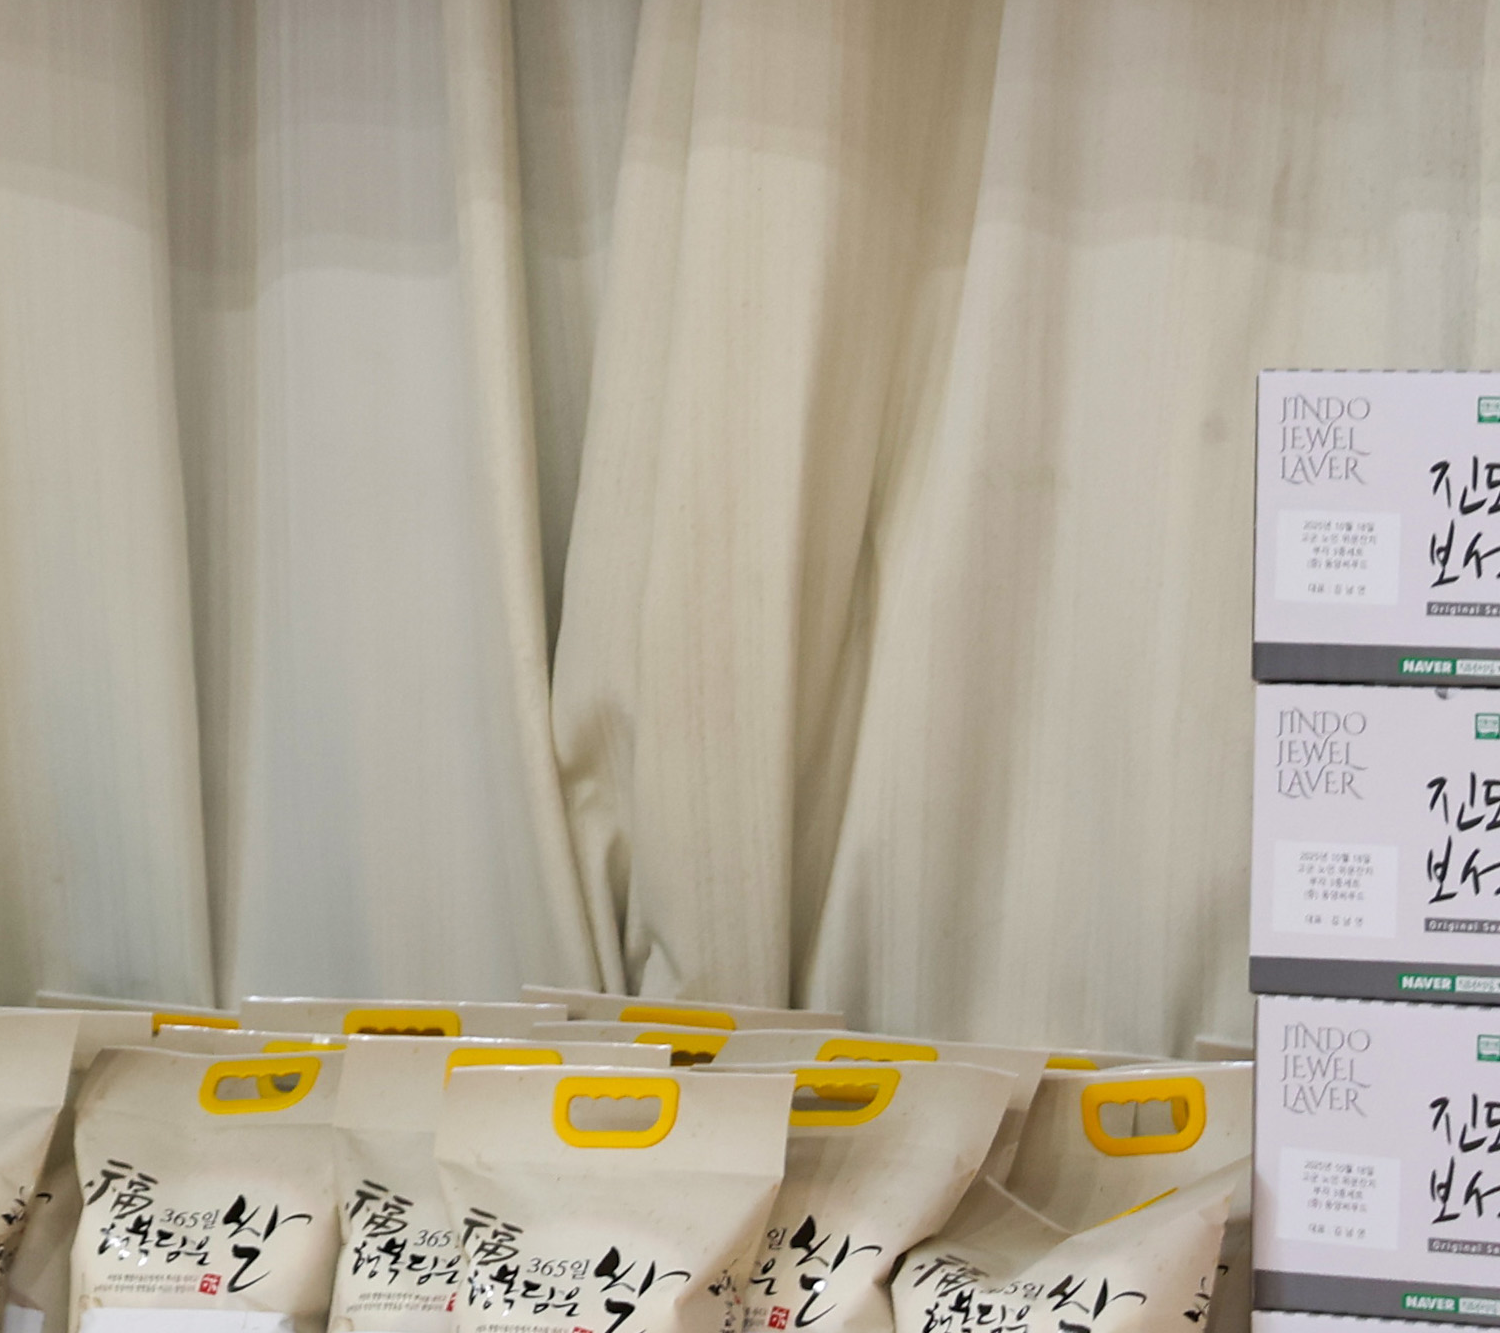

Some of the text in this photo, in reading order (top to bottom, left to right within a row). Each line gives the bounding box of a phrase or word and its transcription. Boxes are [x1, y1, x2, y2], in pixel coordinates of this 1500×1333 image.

[1280, 393, 1371, 424] JINDO
[1280, 419, 1371, 456] JEWEL
[1281, 453, 1366, 485] LAVER
[1430, 455, 1500, 515] 진
[1430, 603, 1480, 615] Original
[1402, 659, 1452, 673] NAVER
[1277, 707, 1367, 737] JINDO
[1277, 733, 1368, 771] JEWEL
[1277, 765, 1363, 799] LAVER
[1427, 771, 1500, 832] 진
[1429, 920, 1478, 931] Original
[1402, 975, 1452, 990] NAVER
[1281, 1023, 1371, 1054] JINDO
[1281, 1050, 1372, 1088] JEWEL
[1282, 1082, 1368, 1117] LAVER
[1429, 1093, 1500, 1153] 진
[159, 1208, 220, 1229] 365일
[222, 1194, 313, 1293] 쌀
[1432, 1240, 1481, 1253] Original
[352, 1237, 461, 1286] 행복담은
[526, 1257, 590, 1280] 365일
[789, 1215, 882, 1328] 쌀
[1405, 1295, 1455, 1310] NAVER
